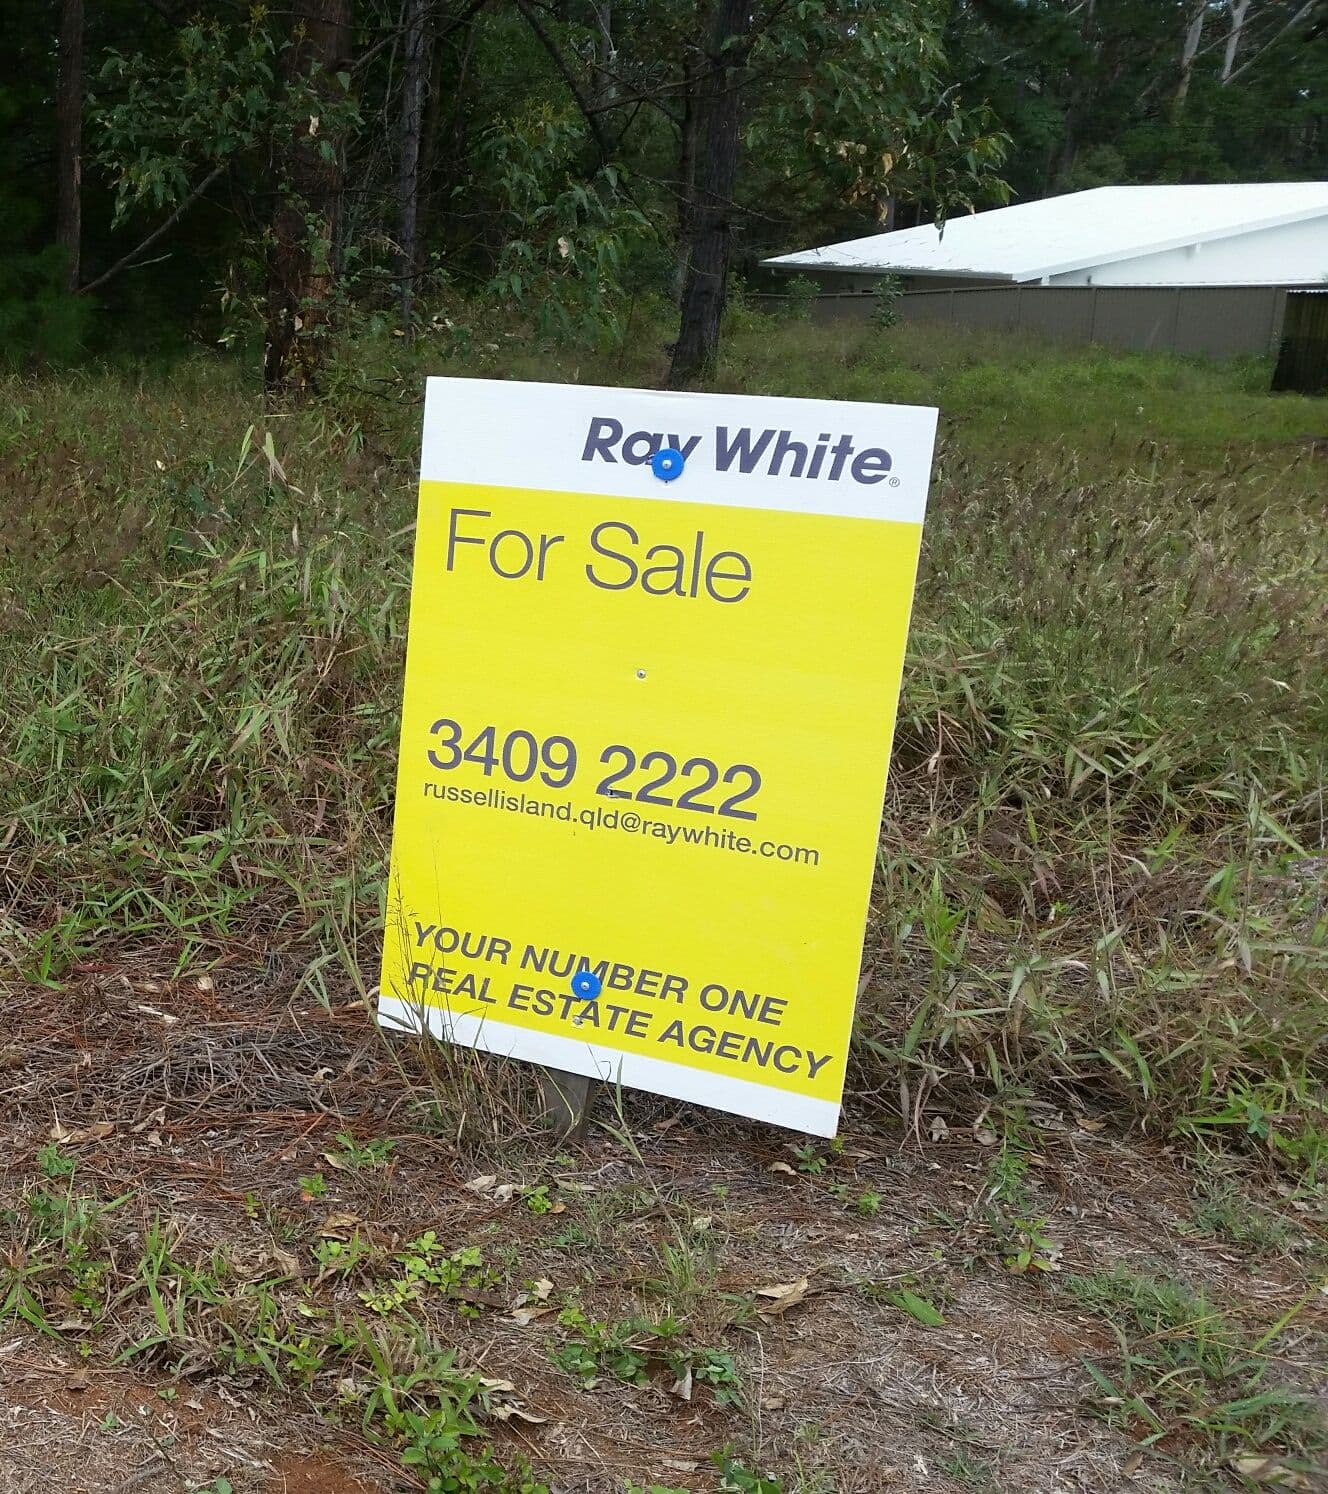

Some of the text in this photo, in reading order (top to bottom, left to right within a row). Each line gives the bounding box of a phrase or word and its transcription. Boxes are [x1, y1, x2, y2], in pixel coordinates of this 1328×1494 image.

[582, 416, 702, 478] Ray
[447, 508, 752, 603] For Sale
[427, 718, 763, 822] 3409 2222
[423, 779, 821, 866] russellisland.qld@raywhite.com
[407, 961, 834, 1080] REAL ESTATE AGENCY
[413, 921, 789, 1026] YOUR NUMBER ONE
